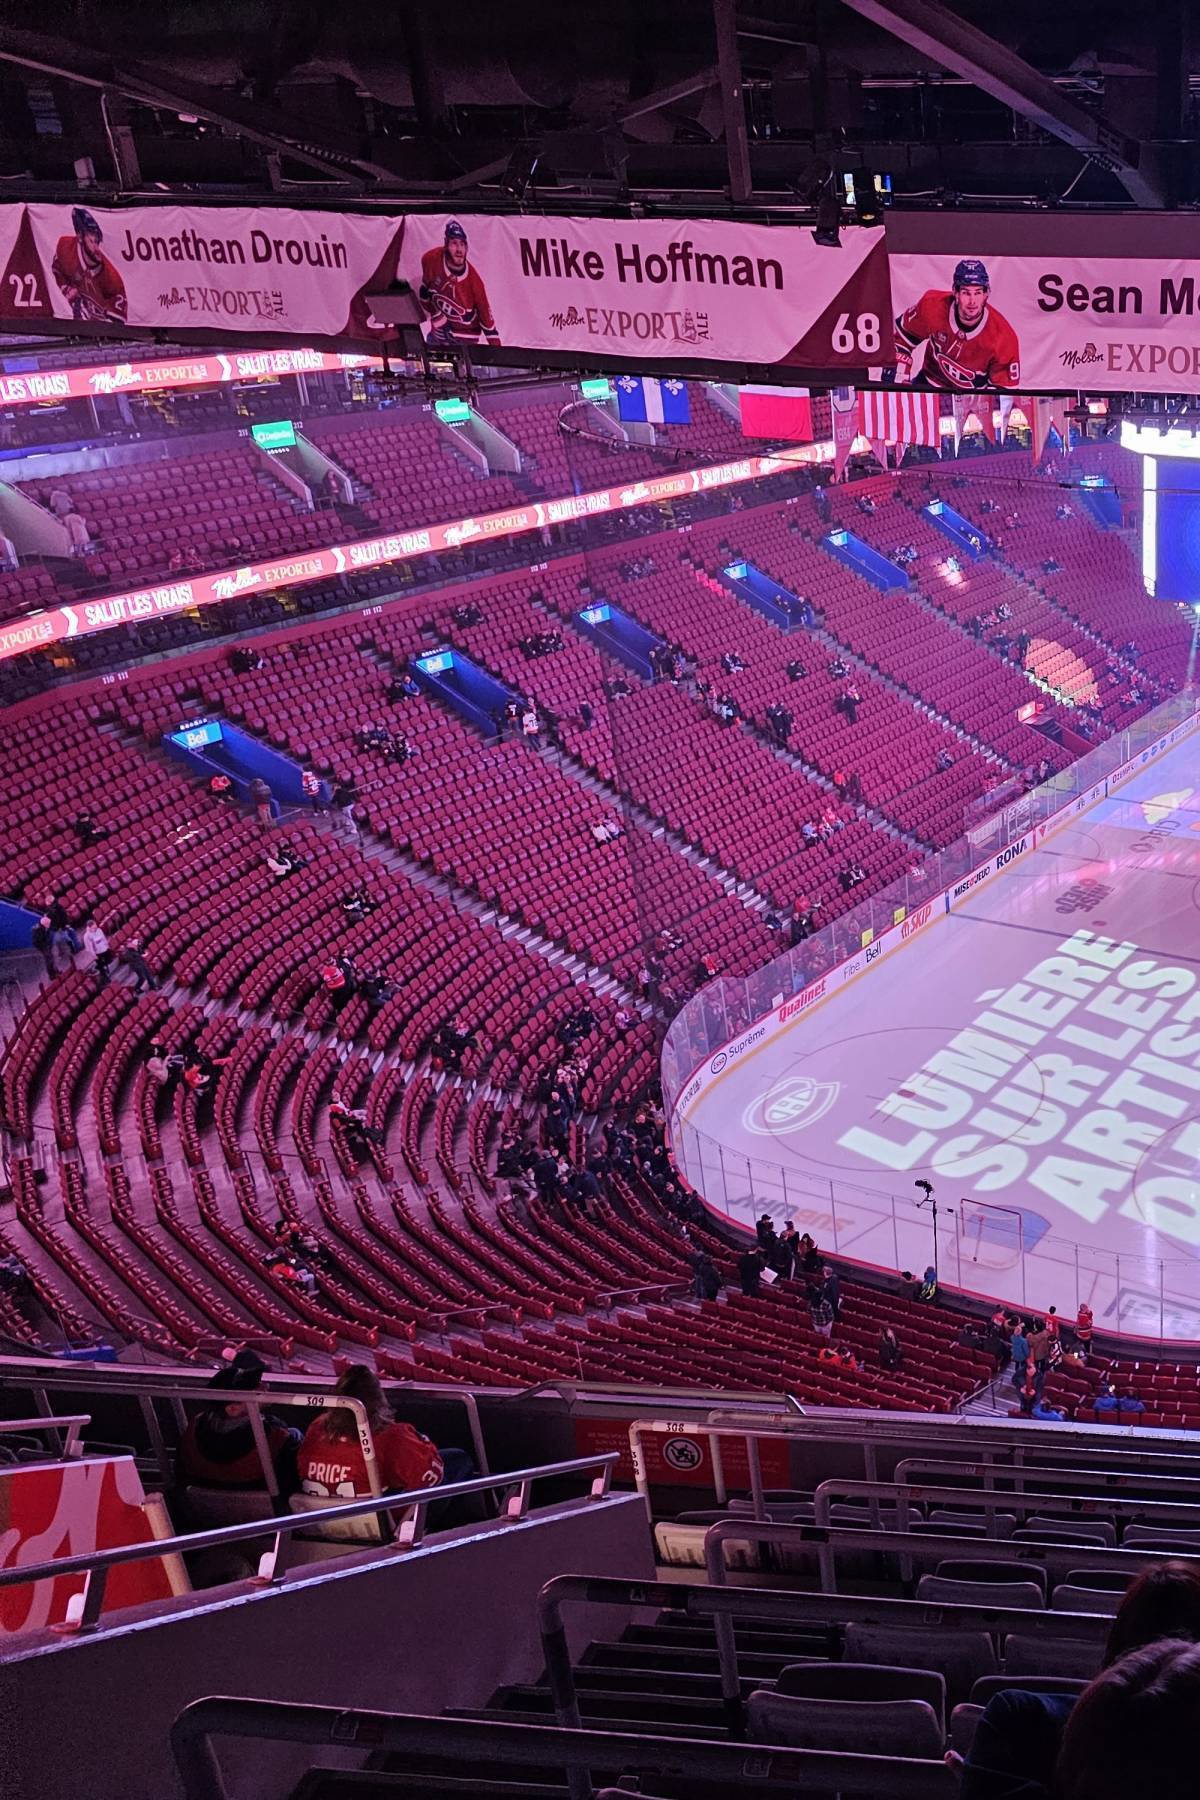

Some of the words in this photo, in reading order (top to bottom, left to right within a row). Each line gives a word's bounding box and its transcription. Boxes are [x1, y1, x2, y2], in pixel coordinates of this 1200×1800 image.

[121, 229, 245, 265] Jonathan
[250, 230, 348, 269] Drouin
[519, 238, 605, 280] Mike
[614, 240, 784, 290] Hoffman
[9, 273, 42, 307] 22
[157, 290, 186, 309] Molson
[184, 287, 263, 316] EXPORT
[274, 290, 283, 315] ALE
[1036, 273, 1142, 314] Sean
[549, 307, 585, 330] Molson
[587, 308, 682, 340] EXPORT
[697, 311, 709, 340] ALE
[831, 312, 881, 353] 68
[236, 353, 271, 376] SALUT
[271, 353, 292, 373] LES
[291, 351, 324, 369] VRAIS!
[1059, 344, 1104, 369] Molson
[0, 378, 26, 401] LES
[27, 373, 71, 398] VRAIS!
[89, 365, 143, 394] Molson
[145, 365, 193, 383] EXPORT
[548, 502, 574, 520] SALUT
[574, 498, 587, 516] LES
[586, 492, 611, 512] VRAIS!
[483, 515, 519, 533] EXPORT
[350, 543, 381, 565] SALUT
[381, 538, 401, 558] LES
[400, 531, 431, 553] VRAIS!
[211, 570, 262, 598] Molson
[264, 561, 312, 583] EXPORT
[84, 602, 127, 626] SALUT
[127, 594, 154, 615] LES
[152, 584, 194, 610] VRAIS!
[0, 626, 41, 650] XPORT
[187, 728, 208, 748] Bell
[996, 839, 1028, 870] RONA
[910, 904, 932, 934] SKIP
[865, 941, 882, 963] Bell
[779, 979, 826, 1023] Qualinet
[728, 1028, 766, 1058] Suprême
[836, 930, 1140, 1170] LUMIÈRE
[931, 1050, 1105, 1191] SUR
[1056, 960, 1199, 1058] LES
[307, 1396, 325, 1407] 309
[359, 1429, 371, 1455] 309
[665, 1422, 685, 1433] 308
[308, 1461, 351, 1484] PRICE
